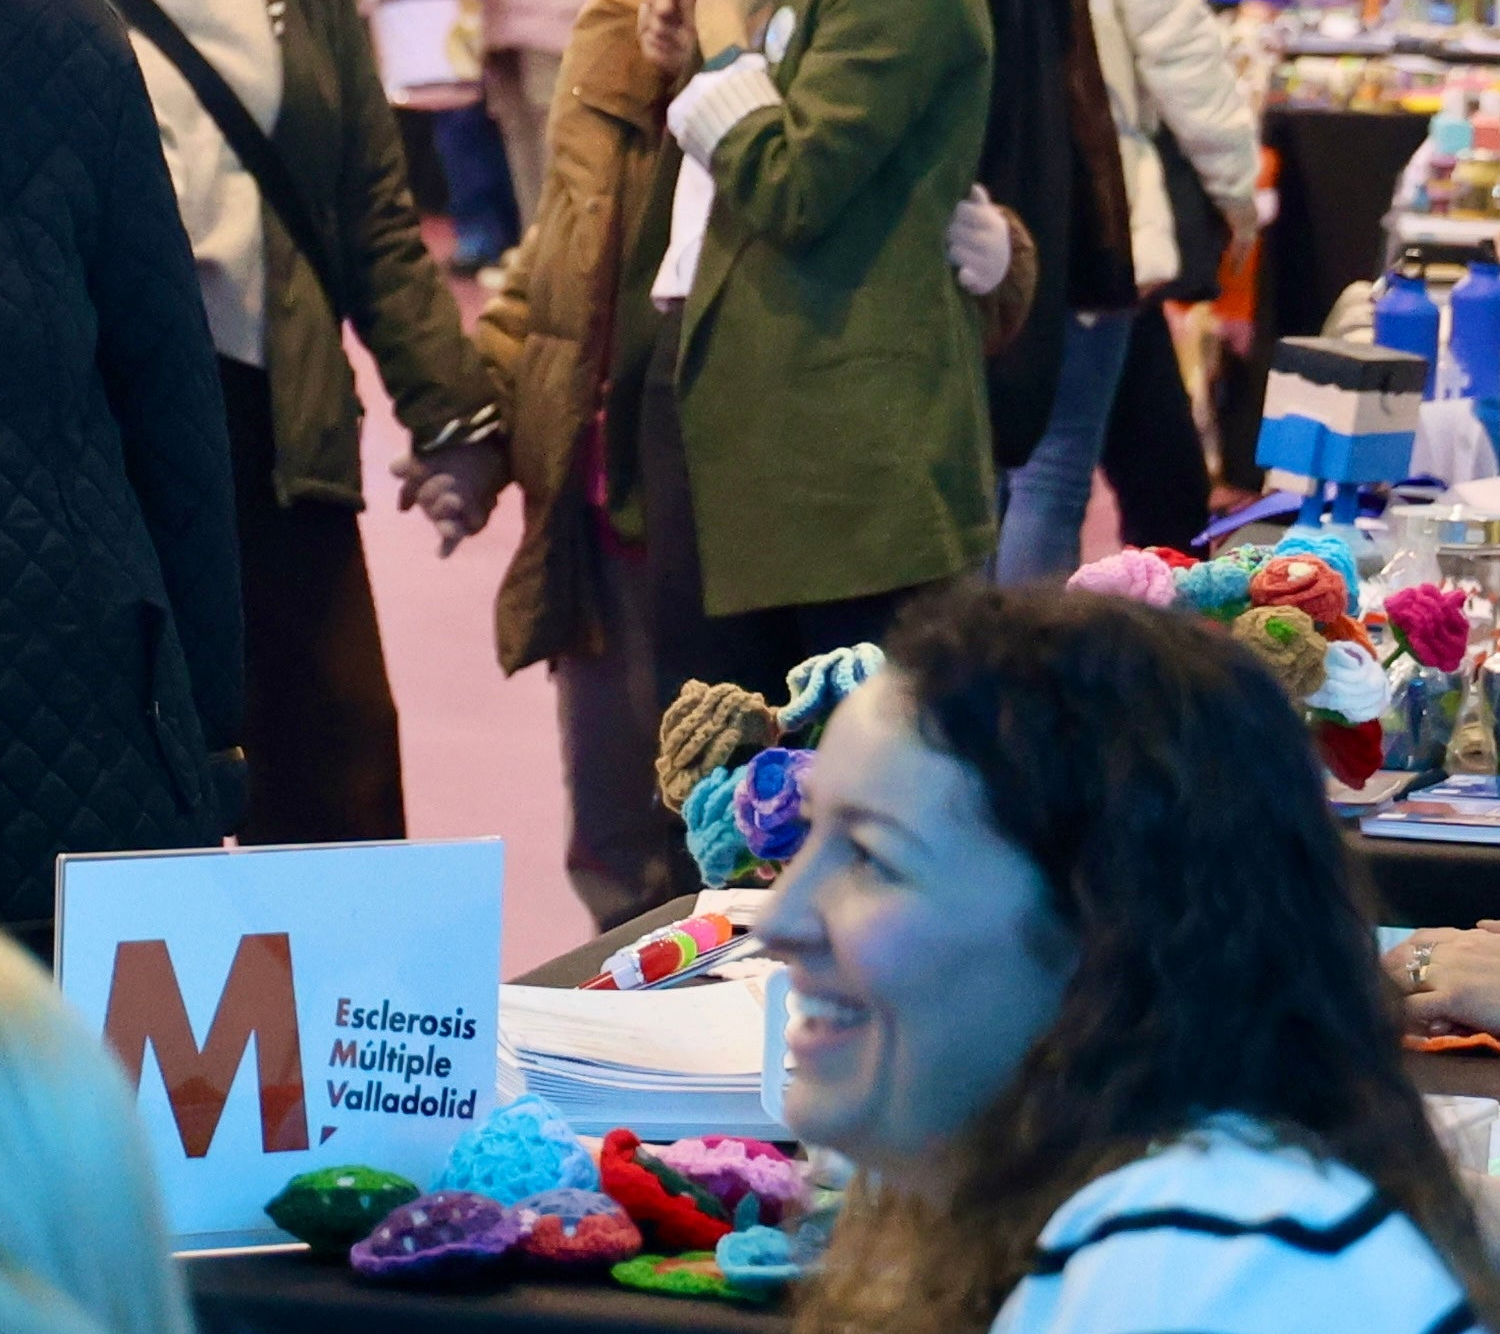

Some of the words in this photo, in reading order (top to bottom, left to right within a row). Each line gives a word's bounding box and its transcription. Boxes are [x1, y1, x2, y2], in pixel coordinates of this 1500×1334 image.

[334, 996, 477, 1040] Esclerosis
[103, 932, 309, 1158] M
[328, 1037, 453, 1084] Múltiple
[326, 1079, 477, 1120] Valladolid
